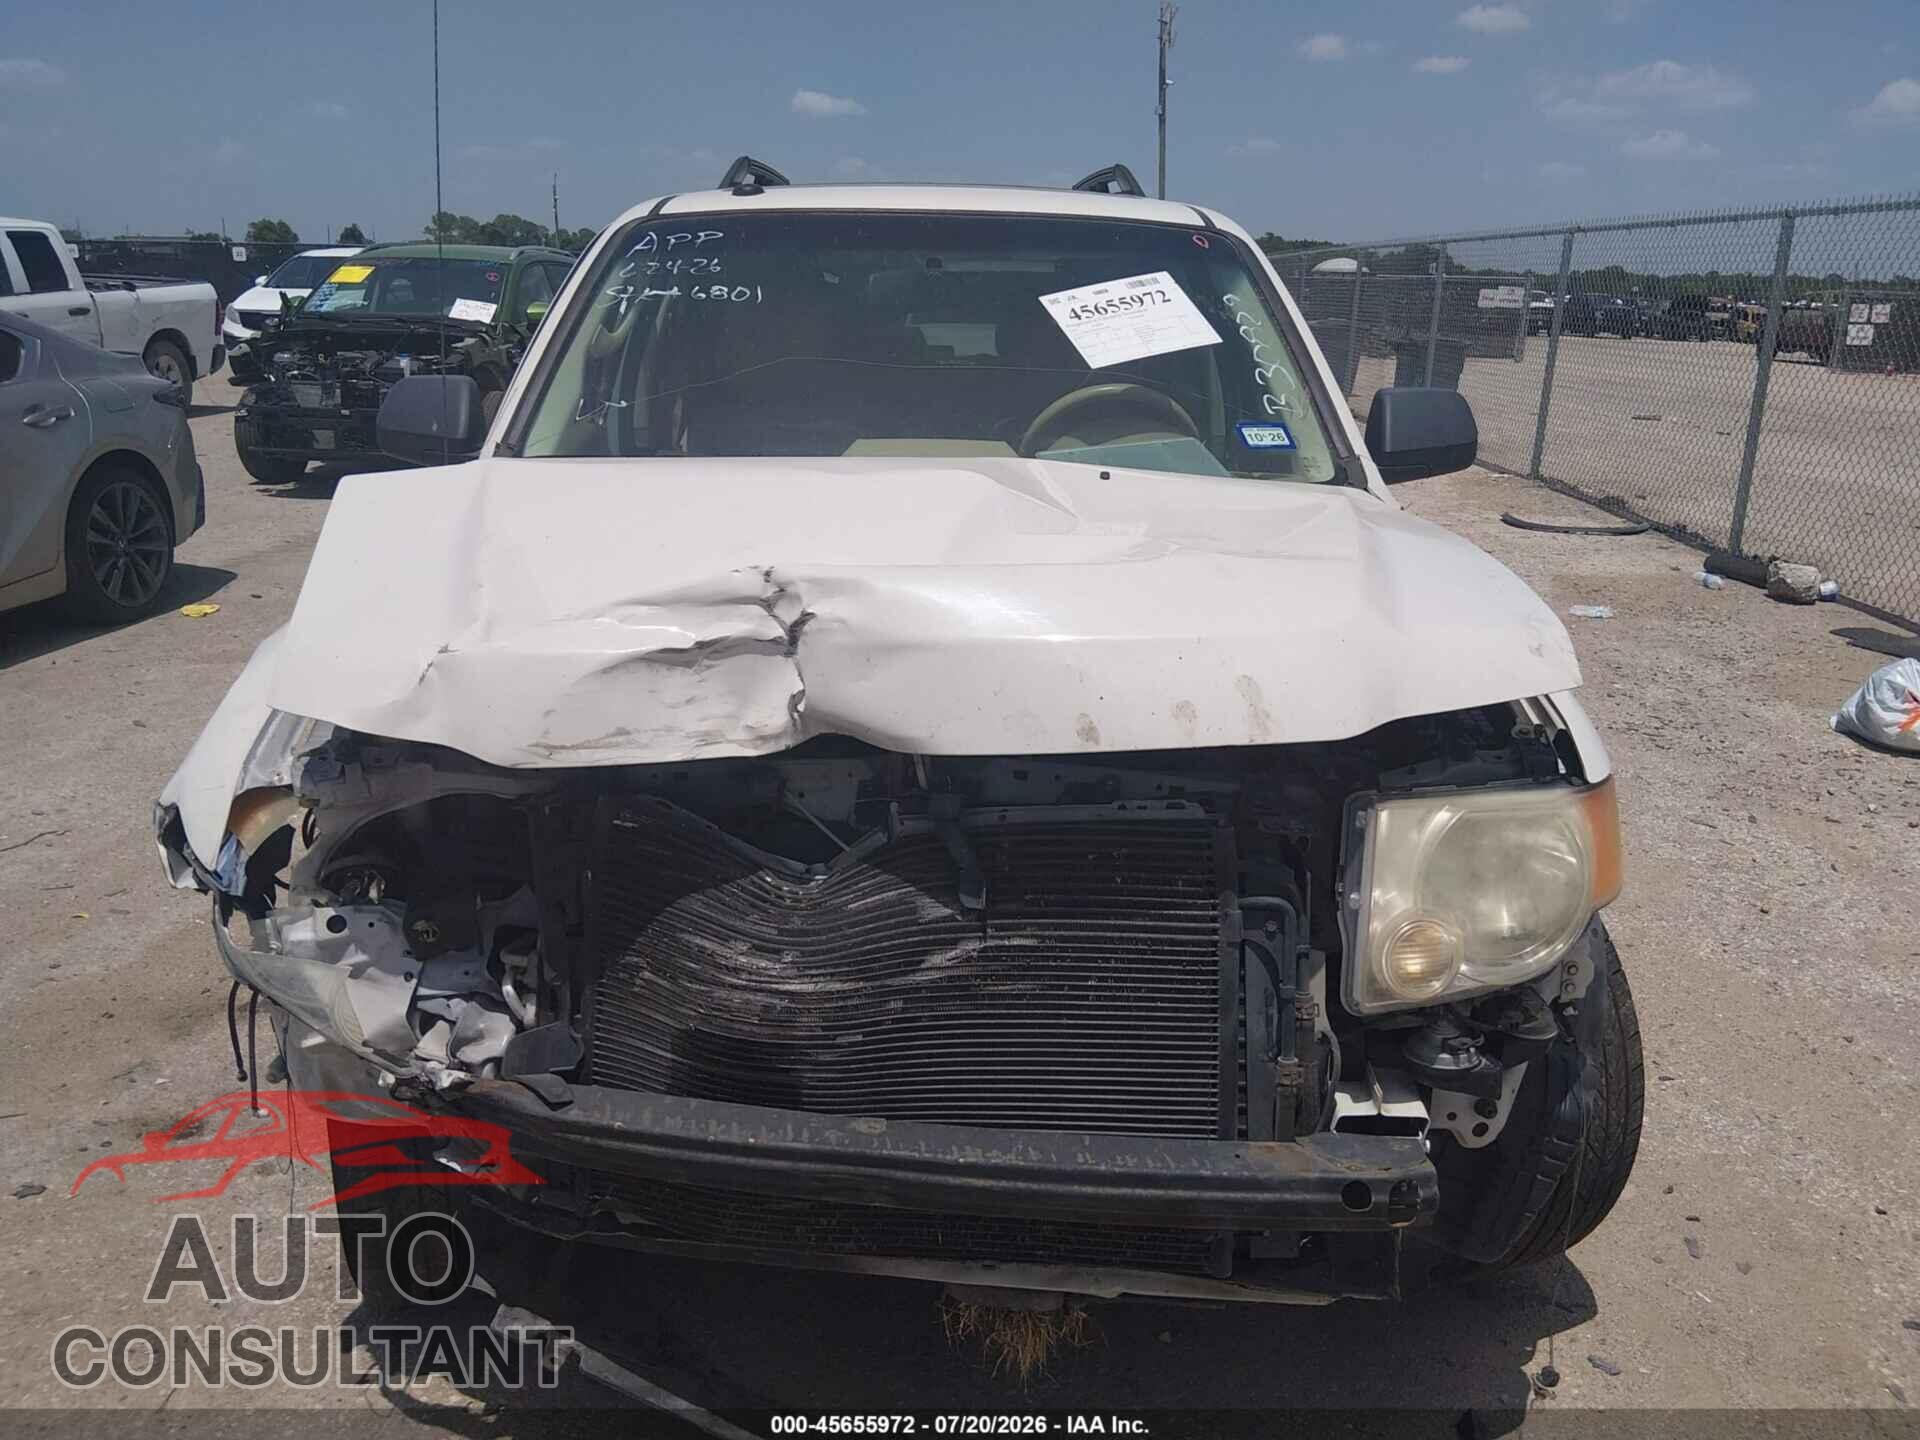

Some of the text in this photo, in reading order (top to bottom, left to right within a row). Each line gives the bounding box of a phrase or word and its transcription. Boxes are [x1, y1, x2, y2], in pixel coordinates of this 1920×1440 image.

[626, 230, 724, 258] APP
[690, 284, 762, 304] 6801
[1068, 289, 1172, 321] 45655972
